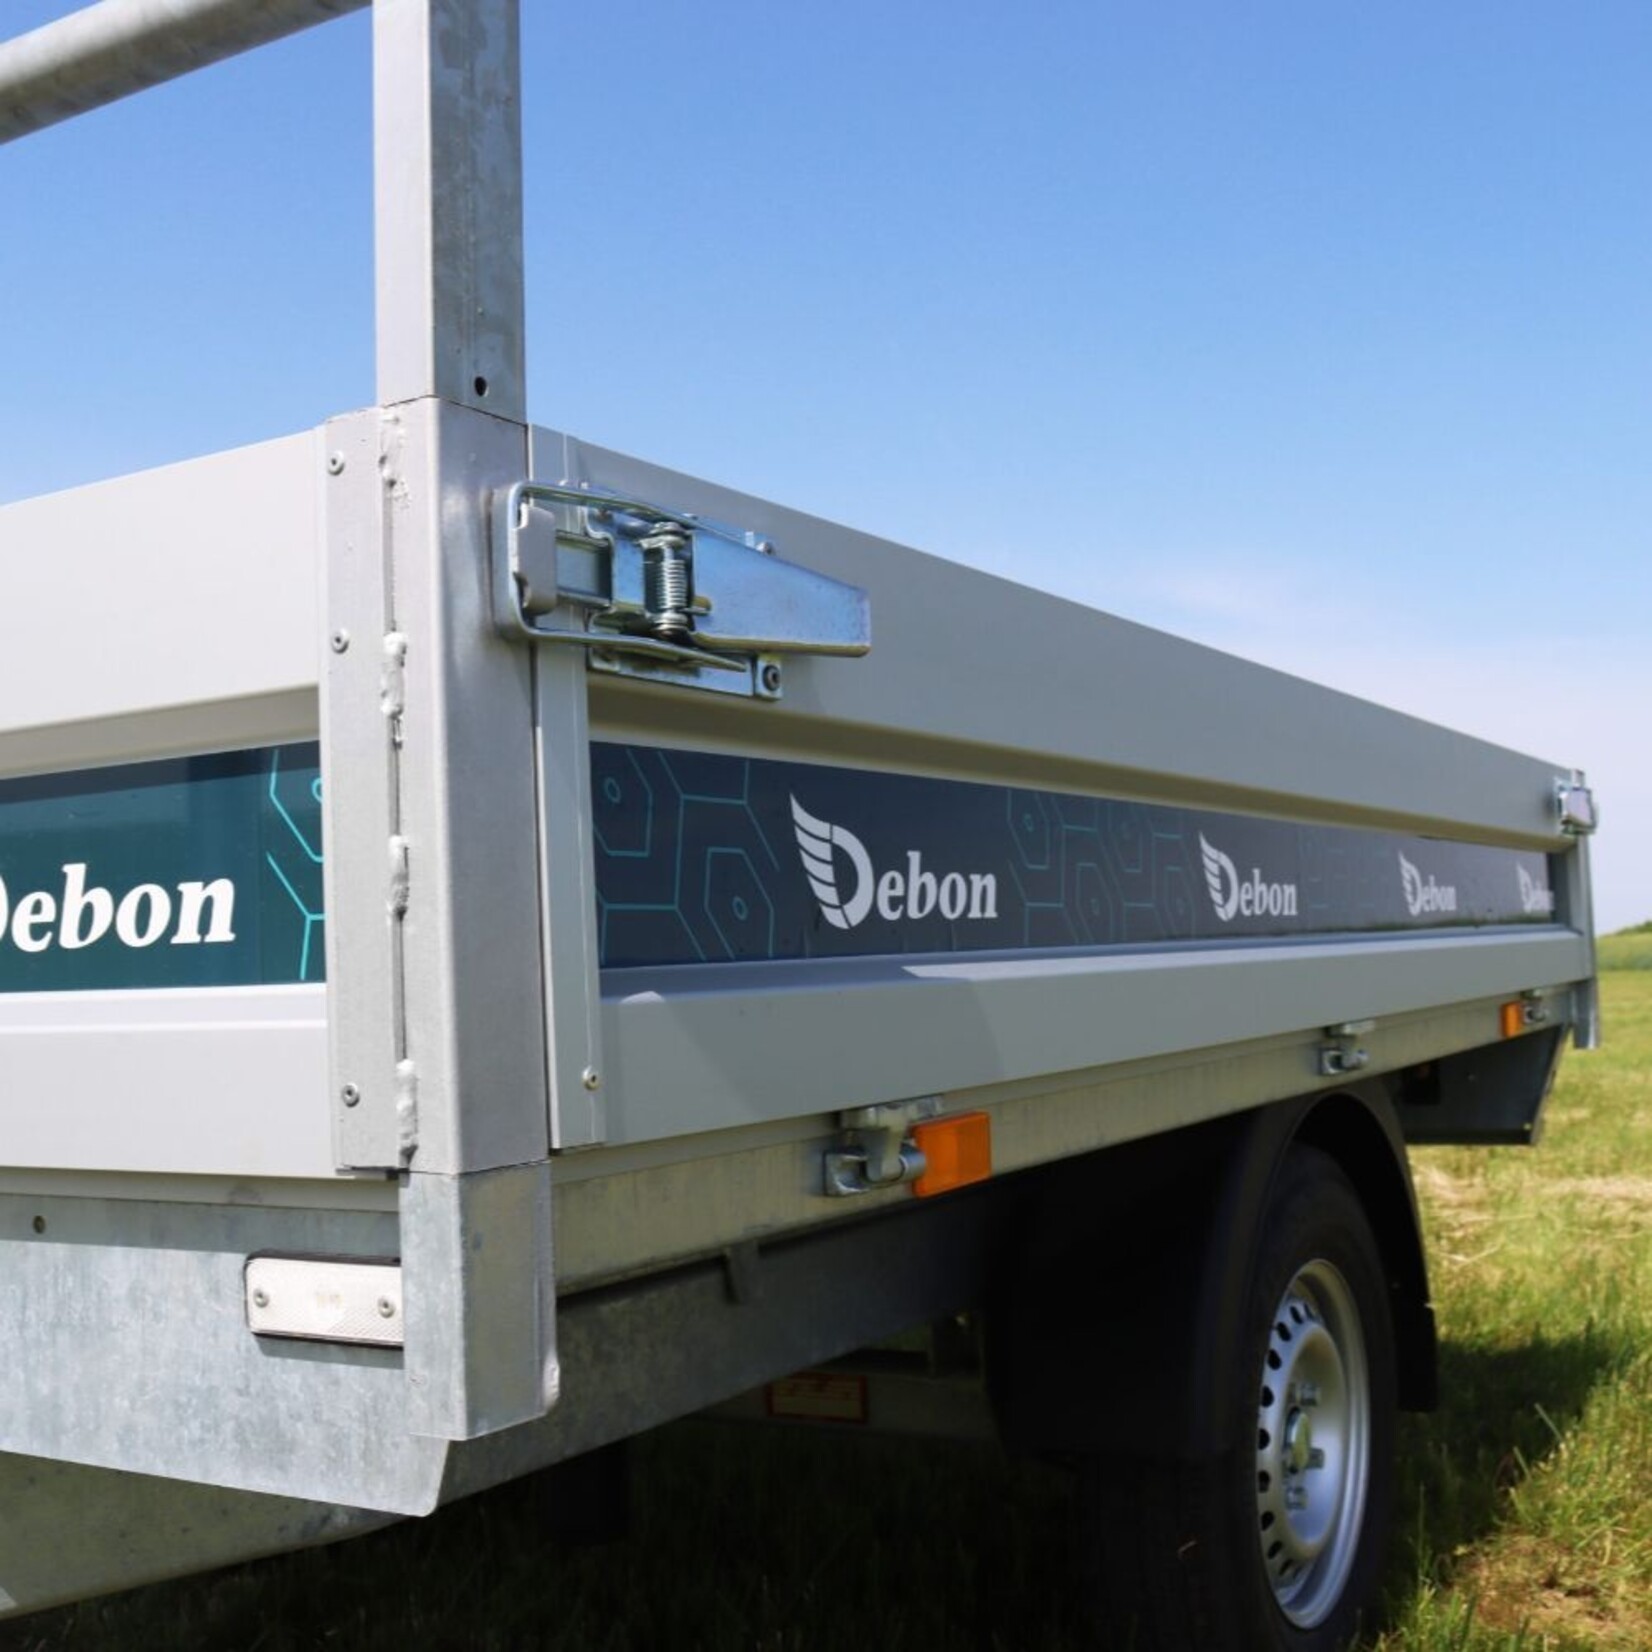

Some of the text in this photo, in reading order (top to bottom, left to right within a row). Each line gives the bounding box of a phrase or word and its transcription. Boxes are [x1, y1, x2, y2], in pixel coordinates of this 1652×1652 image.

[790, 792, 998, 929] Debon
[1199, 831, 1298, 921] Debon
[1399, 851, 1457, 917] Debon
[0, 863, 236, 952] ebon
